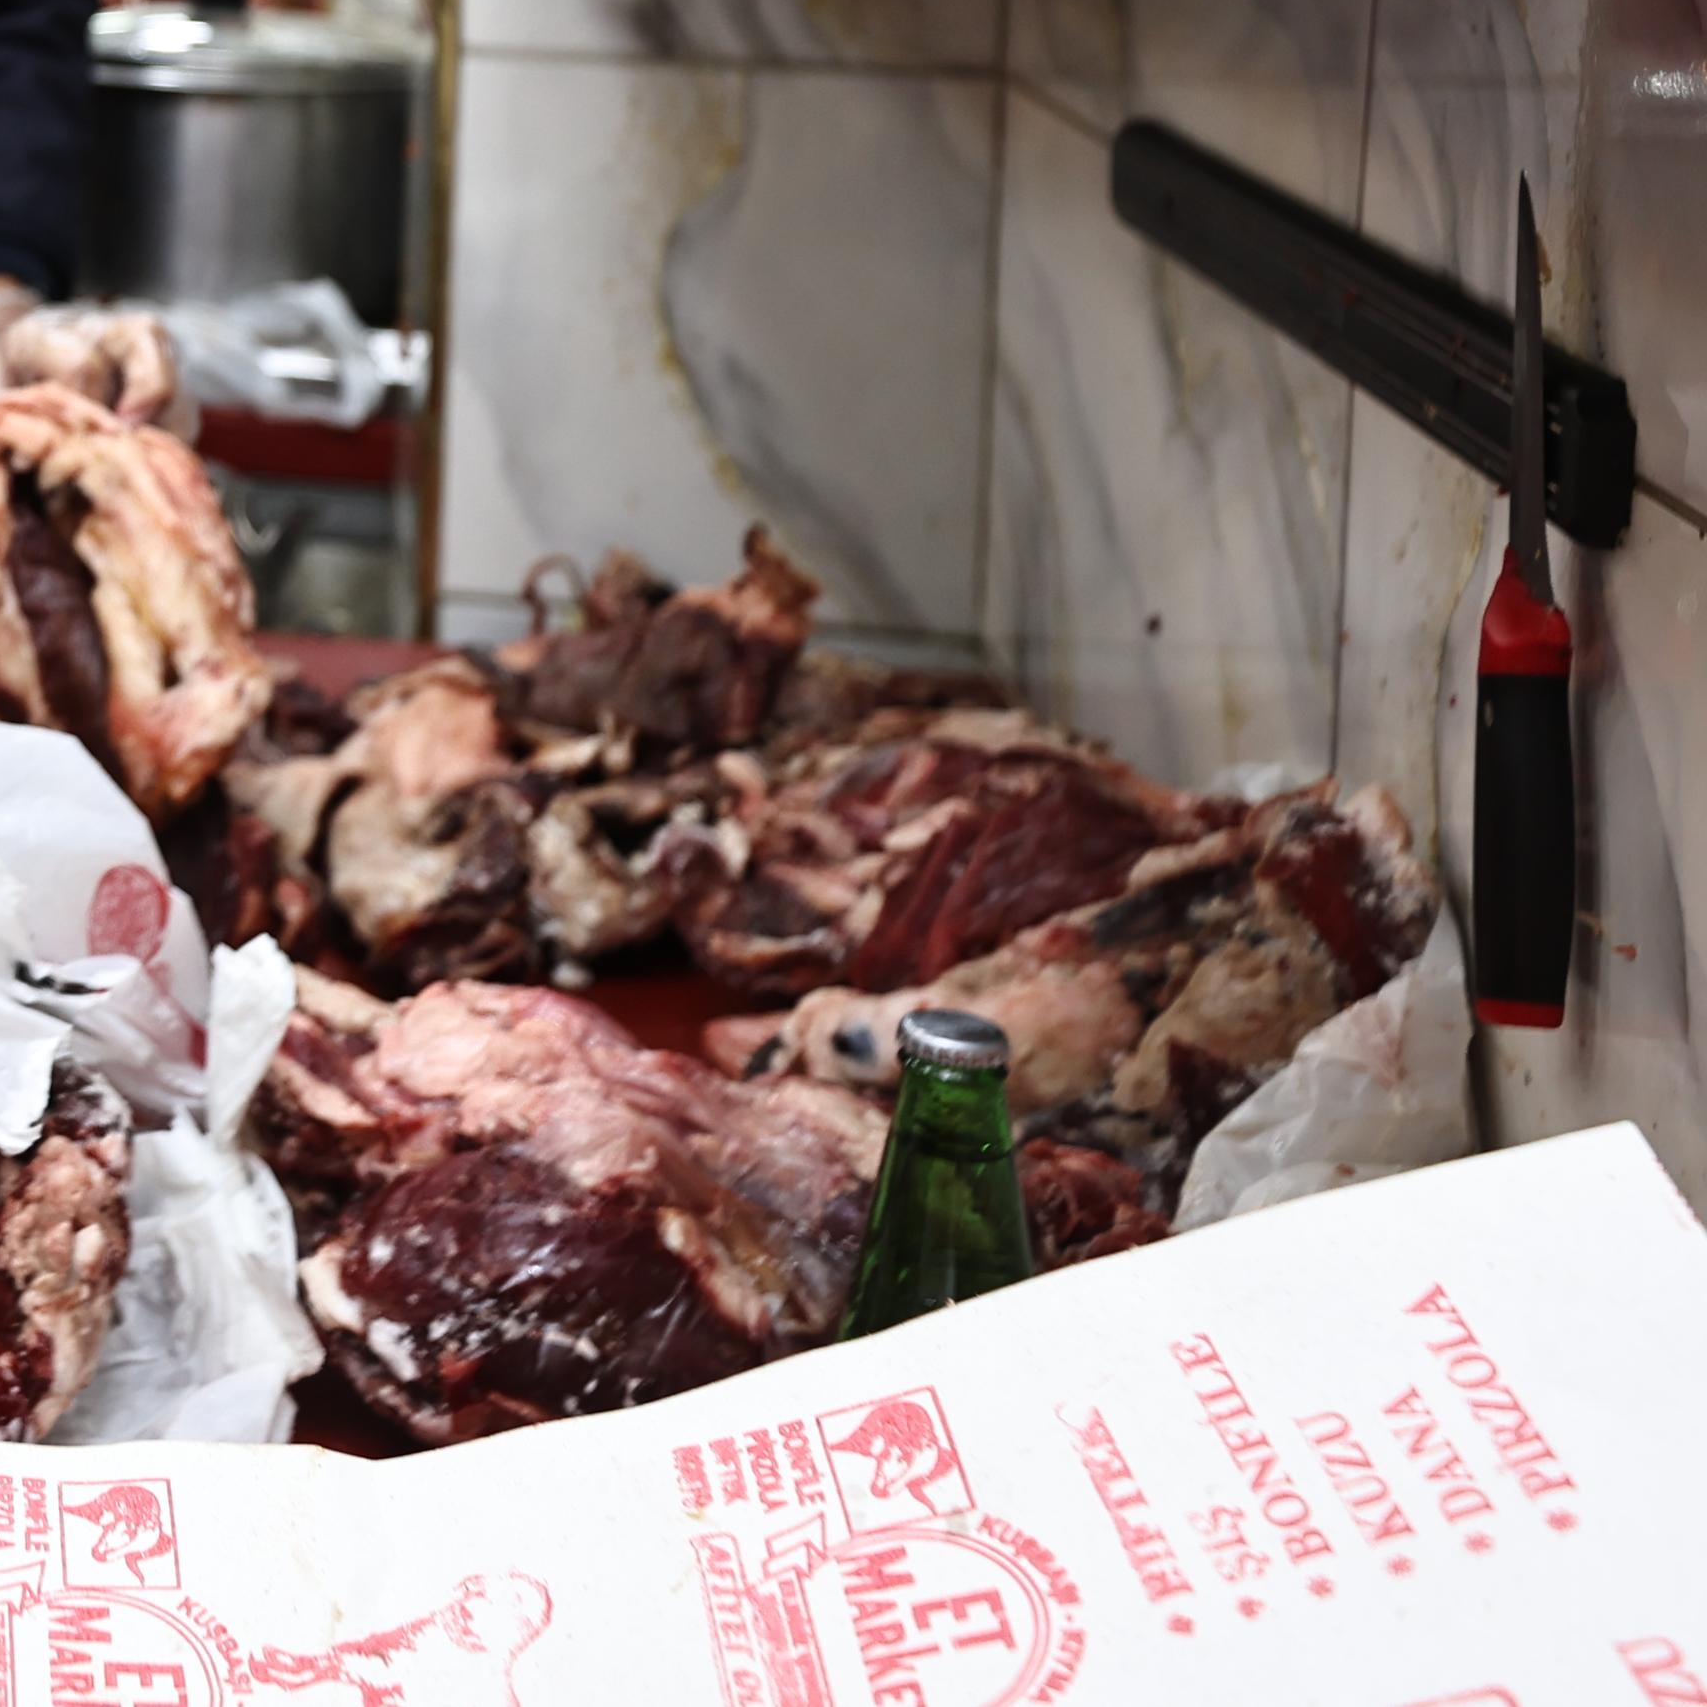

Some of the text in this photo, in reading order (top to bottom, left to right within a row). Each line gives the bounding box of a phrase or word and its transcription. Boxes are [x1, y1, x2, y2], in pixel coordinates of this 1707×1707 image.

[1171, 1333, 1335, 1564] BONFİLE
[1383, 1386, 1495, 1524] DANA
[1404, 1282, 1579, 1499] PİRZOLA
[1295, 1411, 1417, 1546] KUZU
[835, 1546, 940, 1707] MARKE
[912, 1589, 1016, 1650] ET
